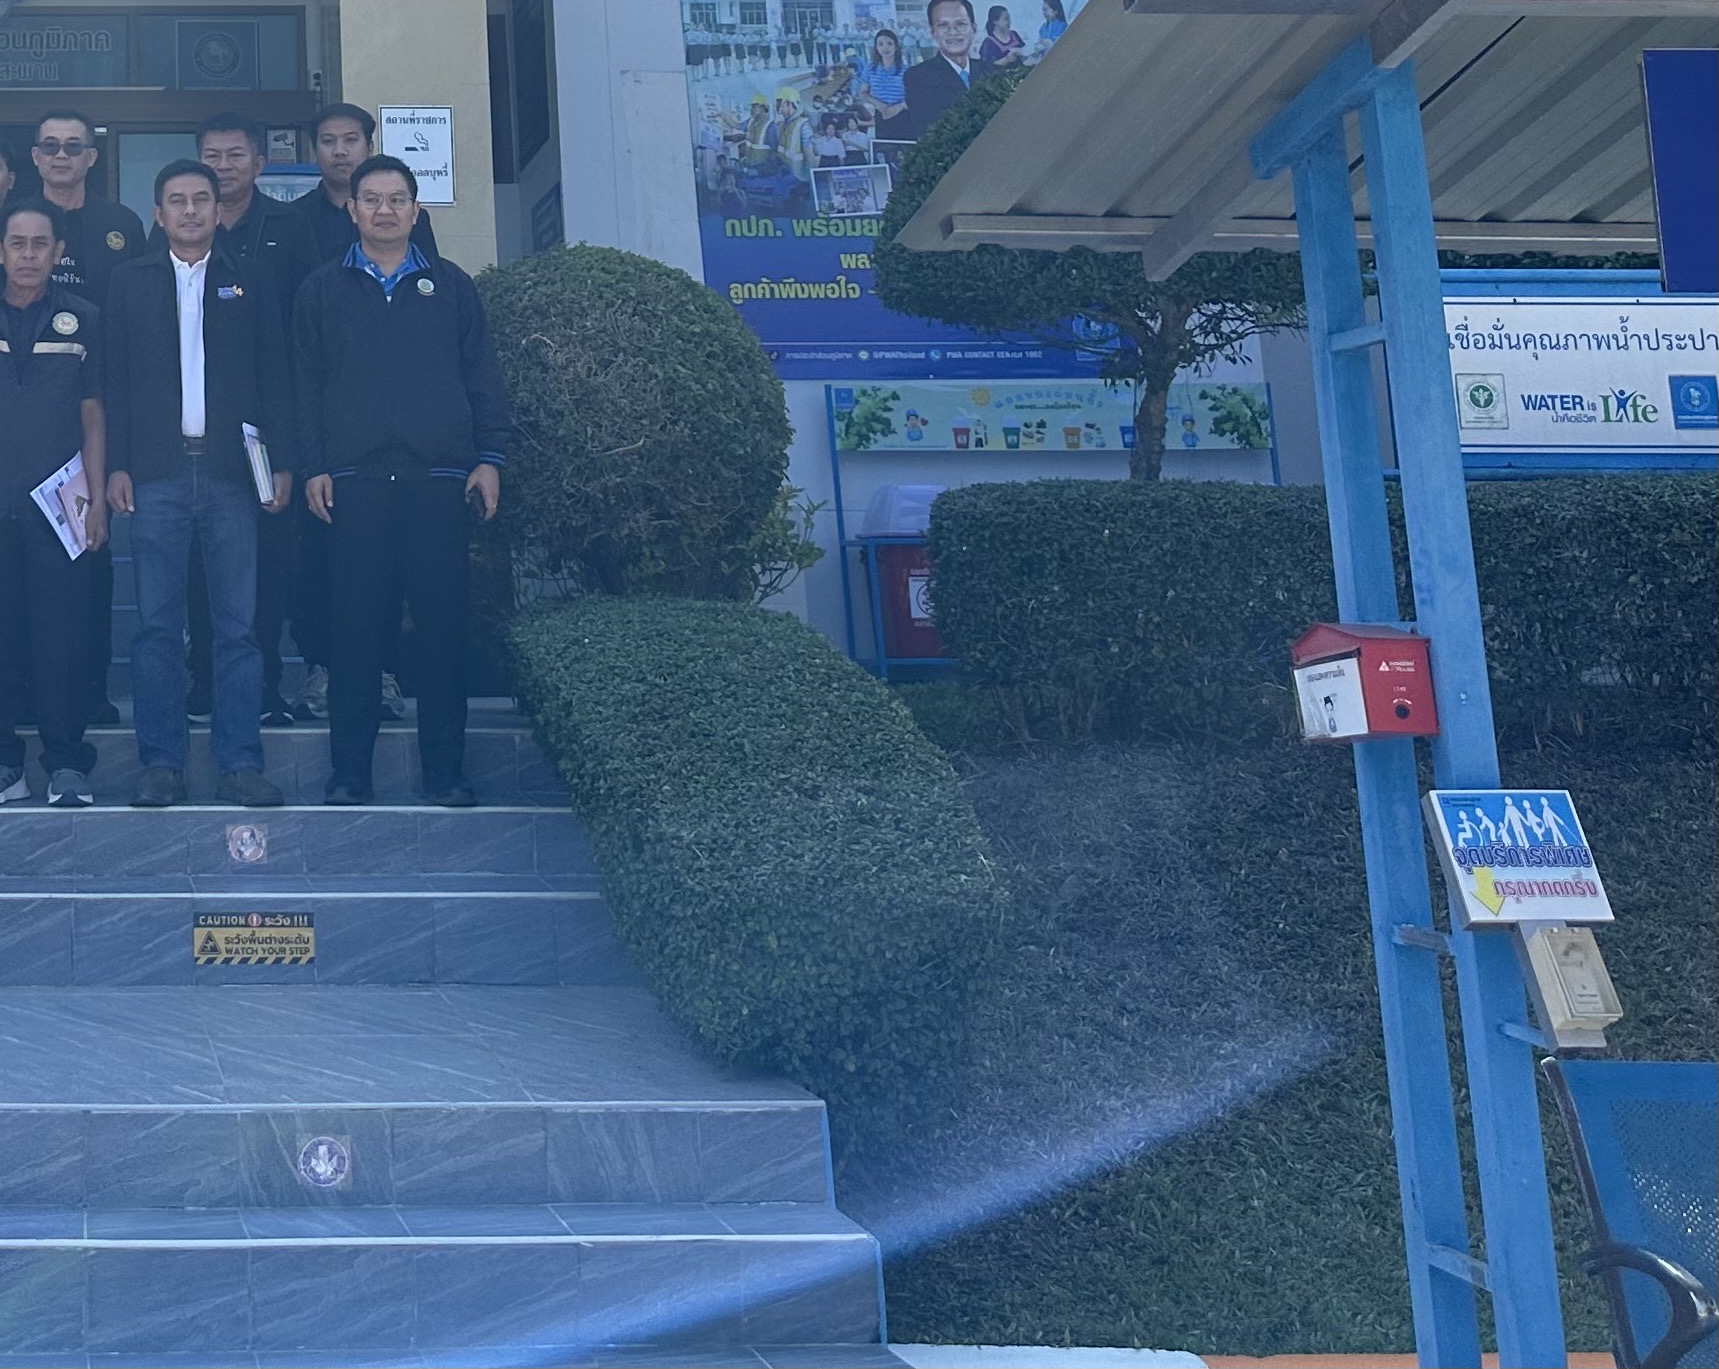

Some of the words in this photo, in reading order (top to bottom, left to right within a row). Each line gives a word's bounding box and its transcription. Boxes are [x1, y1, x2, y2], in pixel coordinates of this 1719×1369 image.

[385, 110, 448, 125] สถานที่ราชการ
[792, 213, 885, 238] พร้อมย
[728, 275, 862, 305] ลูกค้าพึงพอใจ
[1520, 394, 1586, 411] WATER
[1452, 840, 1594, 875] จุดบริการพิเศษ
[1492, 869, 1599, 904] กรุณากดกริ่ง
[199, 915, 245, 925] CAUTION
[264, 914, 291, 926] ระวัง
[224, 930, 310, 945] ระวังพื้นต่างระดับ
[225, 947, 258, 955] WATCH
[261, 947, 286, 955] YOUR
[289, 947, 310, 955] STEP
